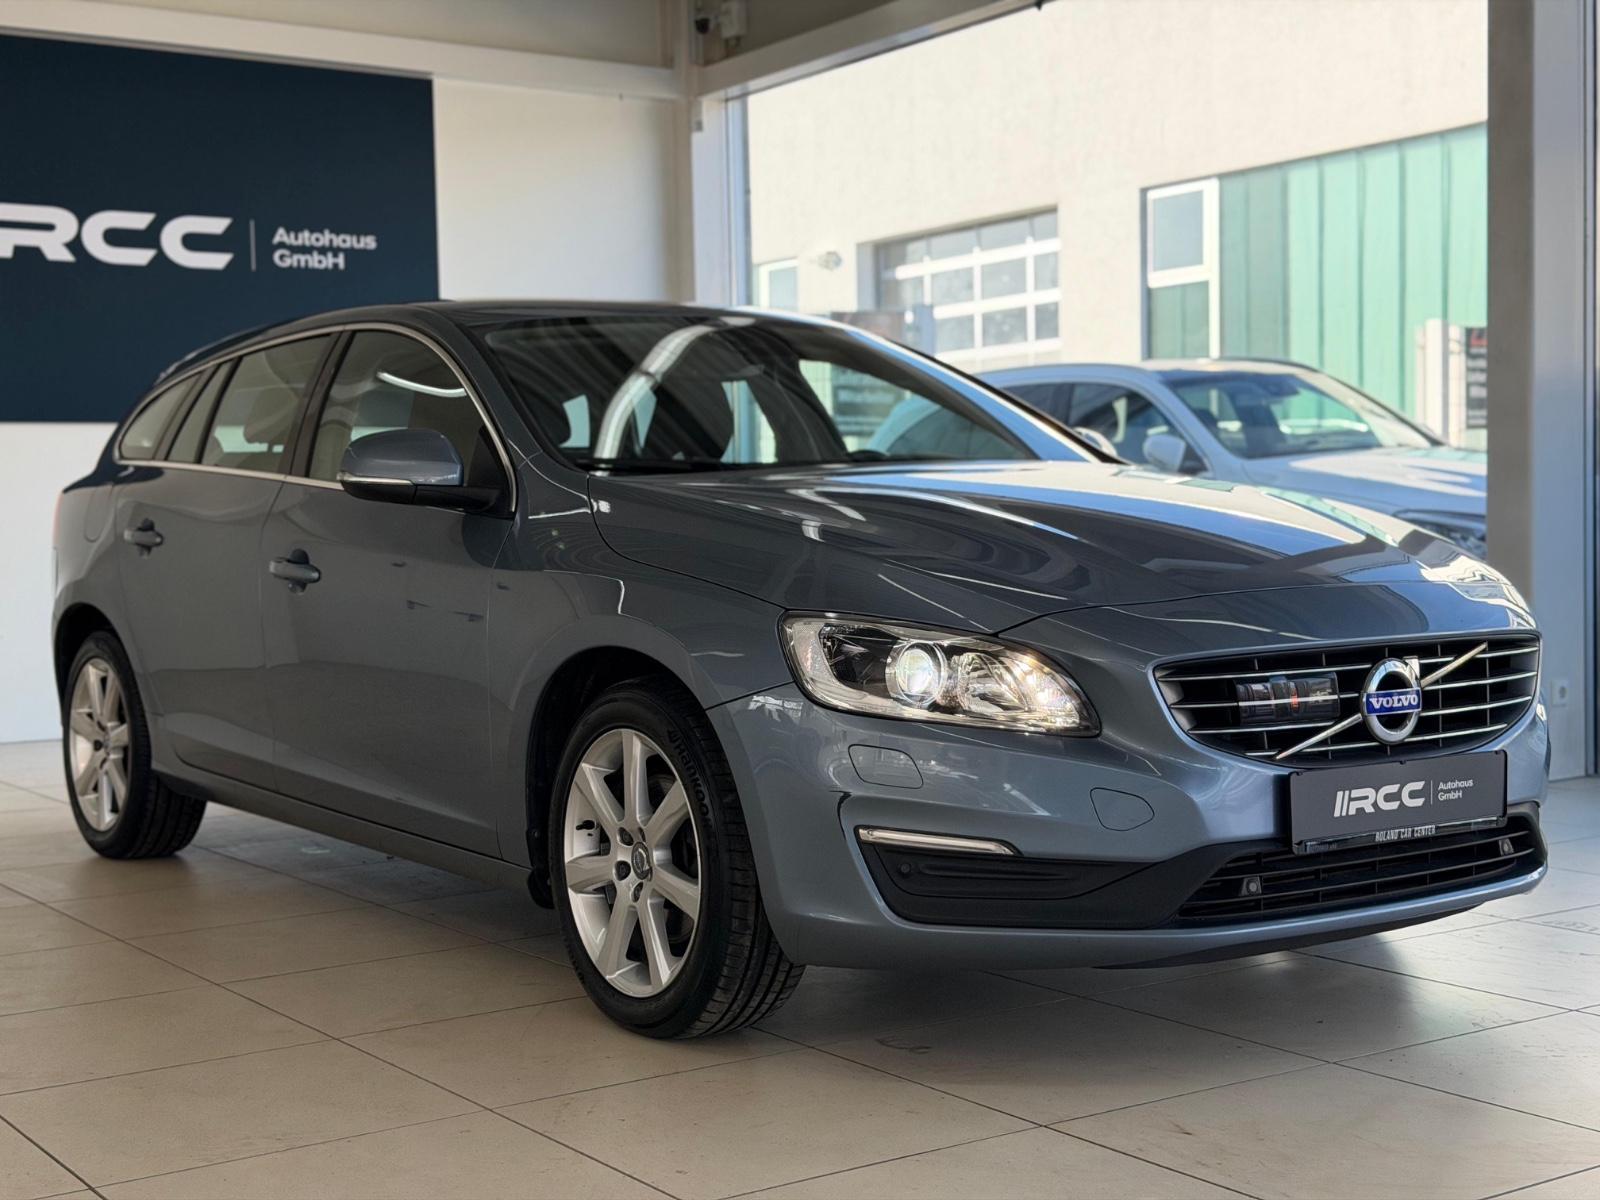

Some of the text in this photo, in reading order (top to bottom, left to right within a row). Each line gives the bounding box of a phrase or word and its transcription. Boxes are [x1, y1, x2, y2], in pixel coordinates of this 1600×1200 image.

[271, 226, 378, 250] Autohaus
[271, 248, 346, 270] GmbH
[1369, 694, 1419, 709] VOLVO
[1438, 779, 1473, 791] Autohaus
[1438, 790, 1462, 801] GmbH
[1413, 825, 1436, 837] CENTER
